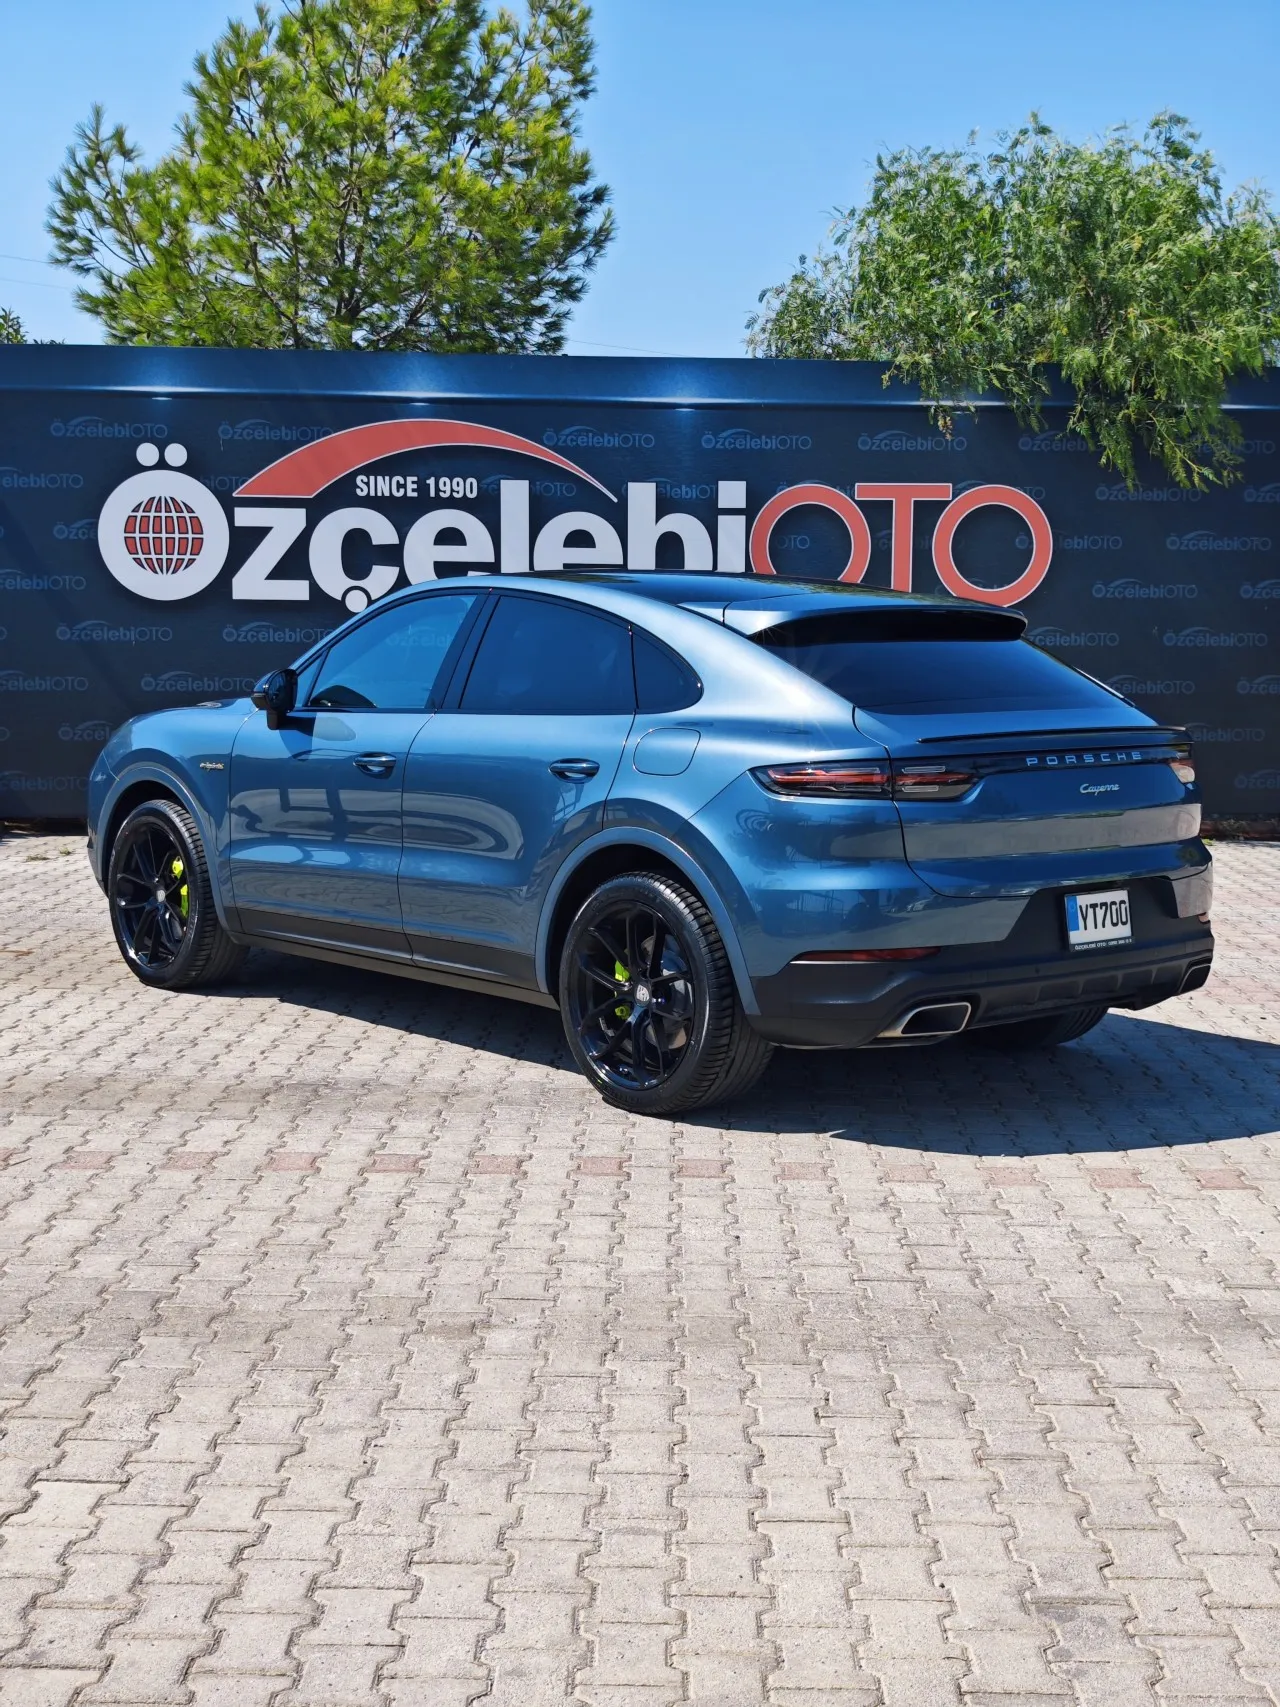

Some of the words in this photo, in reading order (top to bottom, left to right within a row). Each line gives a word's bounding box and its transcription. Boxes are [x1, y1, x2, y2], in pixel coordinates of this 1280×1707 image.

[355, 475, 418, 497] SINCE
[425, 477, 478, 498] 1990
[1026, 751, 1142, 767] PORSCHE
[1079, 783, 1120, 796] Cayenne
[1079, 899, 1129, 931] YT700
